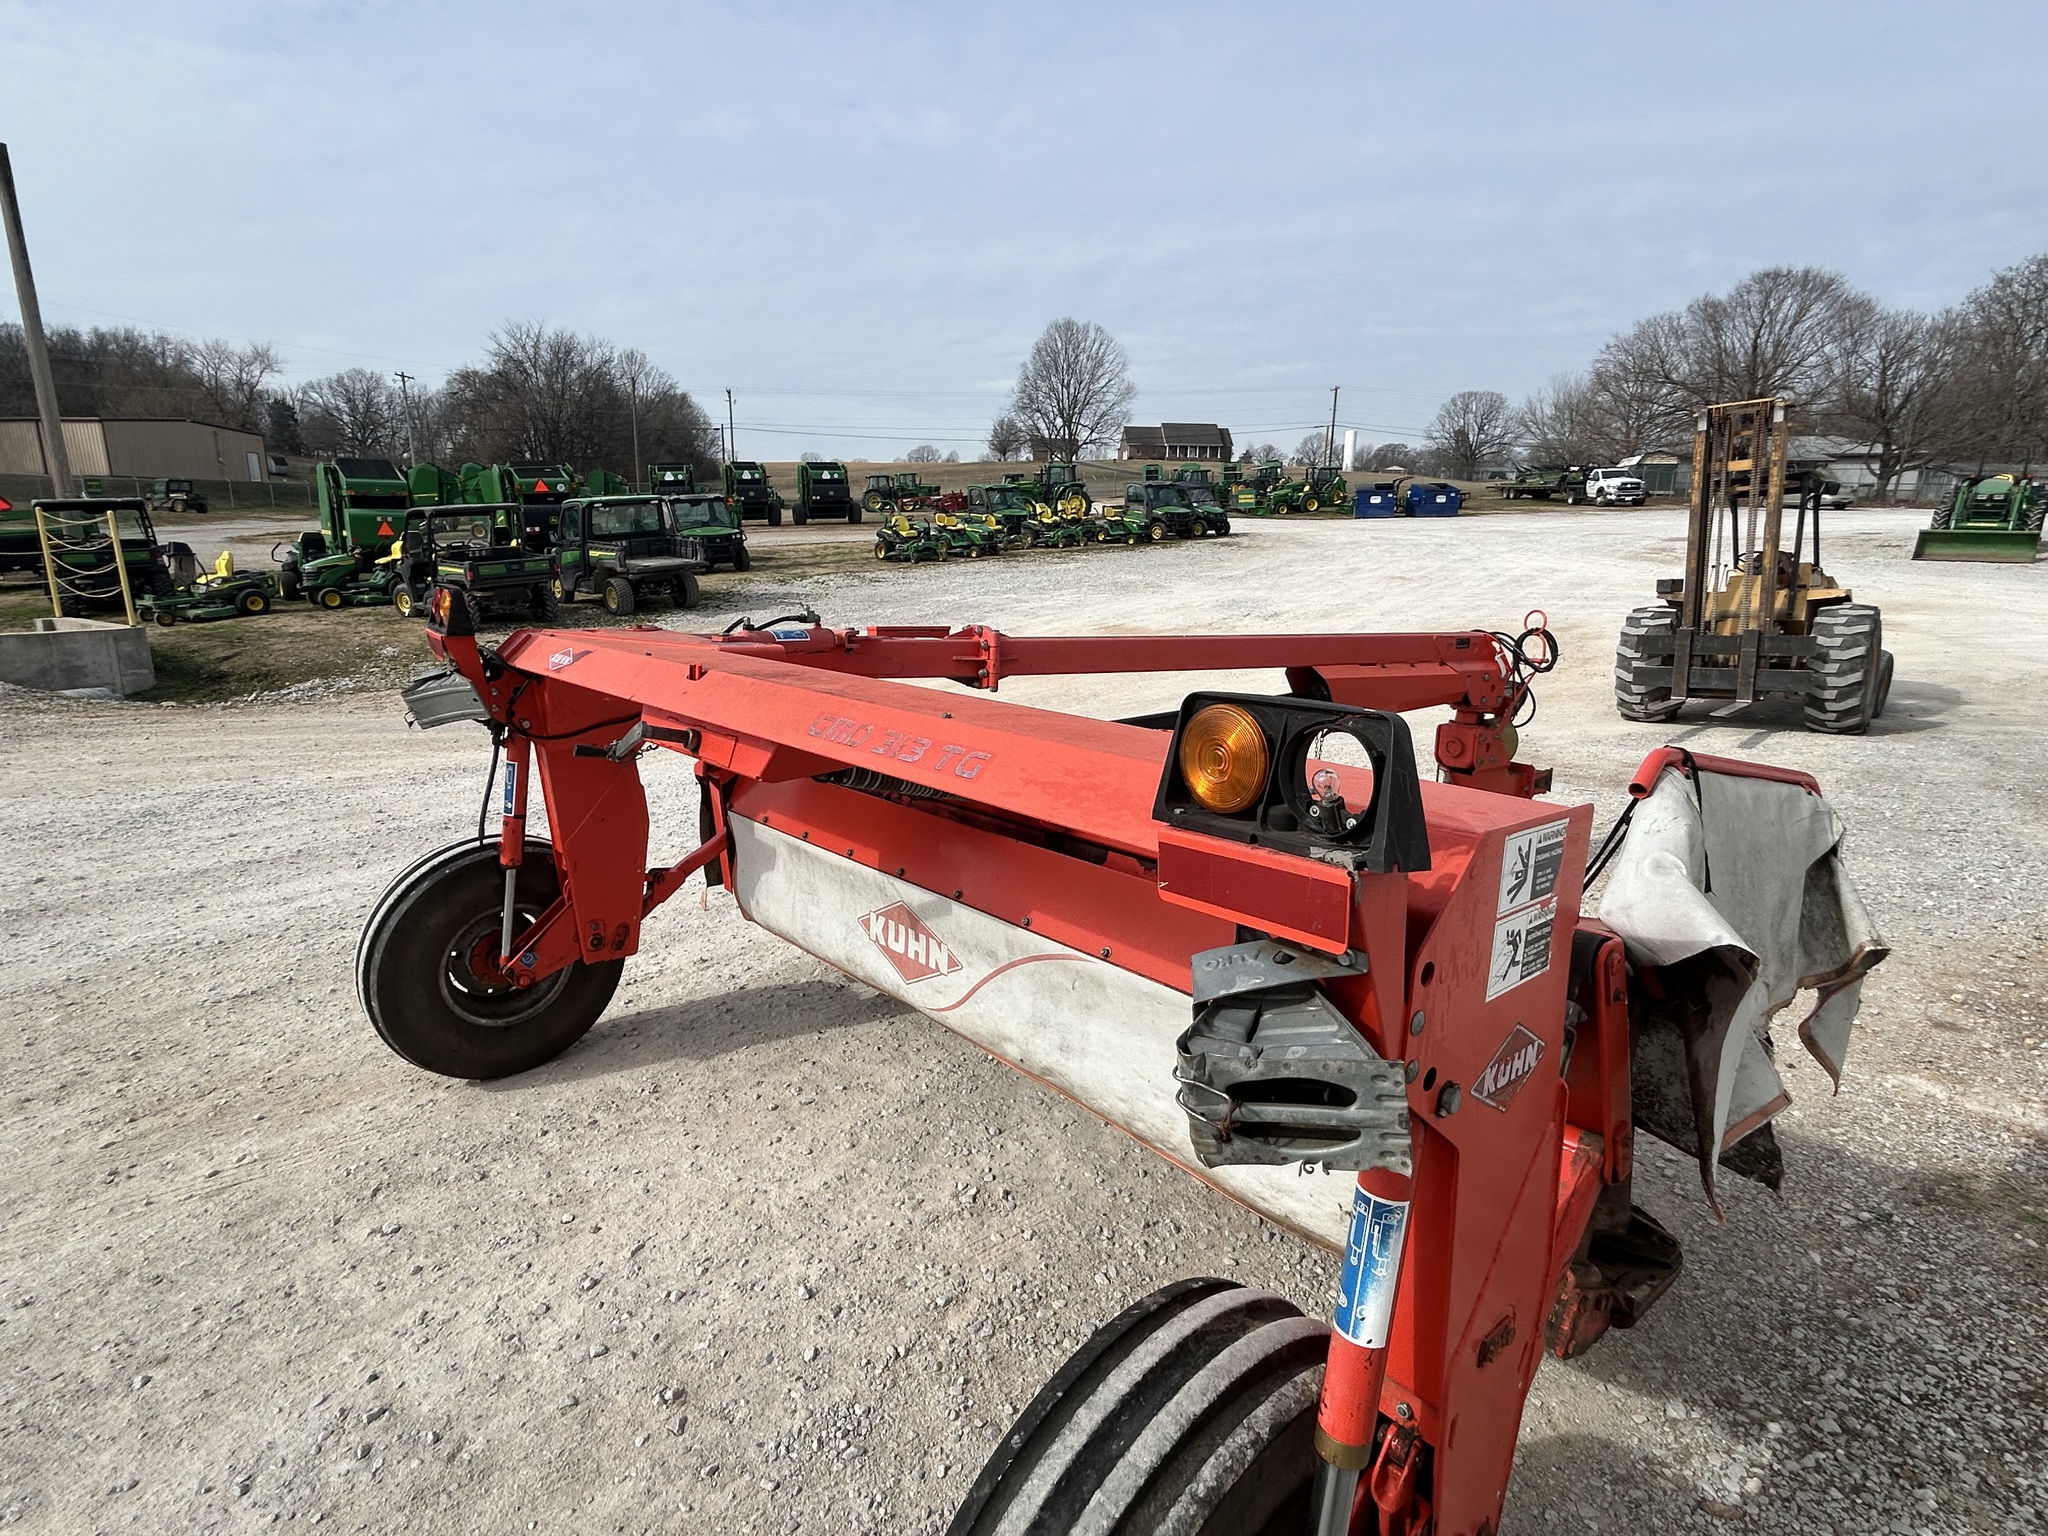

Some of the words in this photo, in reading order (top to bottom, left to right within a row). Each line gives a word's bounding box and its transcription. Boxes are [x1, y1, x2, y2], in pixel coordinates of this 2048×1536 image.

[870, 729, 932, 763] 313
[934, 744, 992, 779] TG
[868, 910, 949, 977] KUHN
[1482, 1040, 1539, 1099] KUHN
